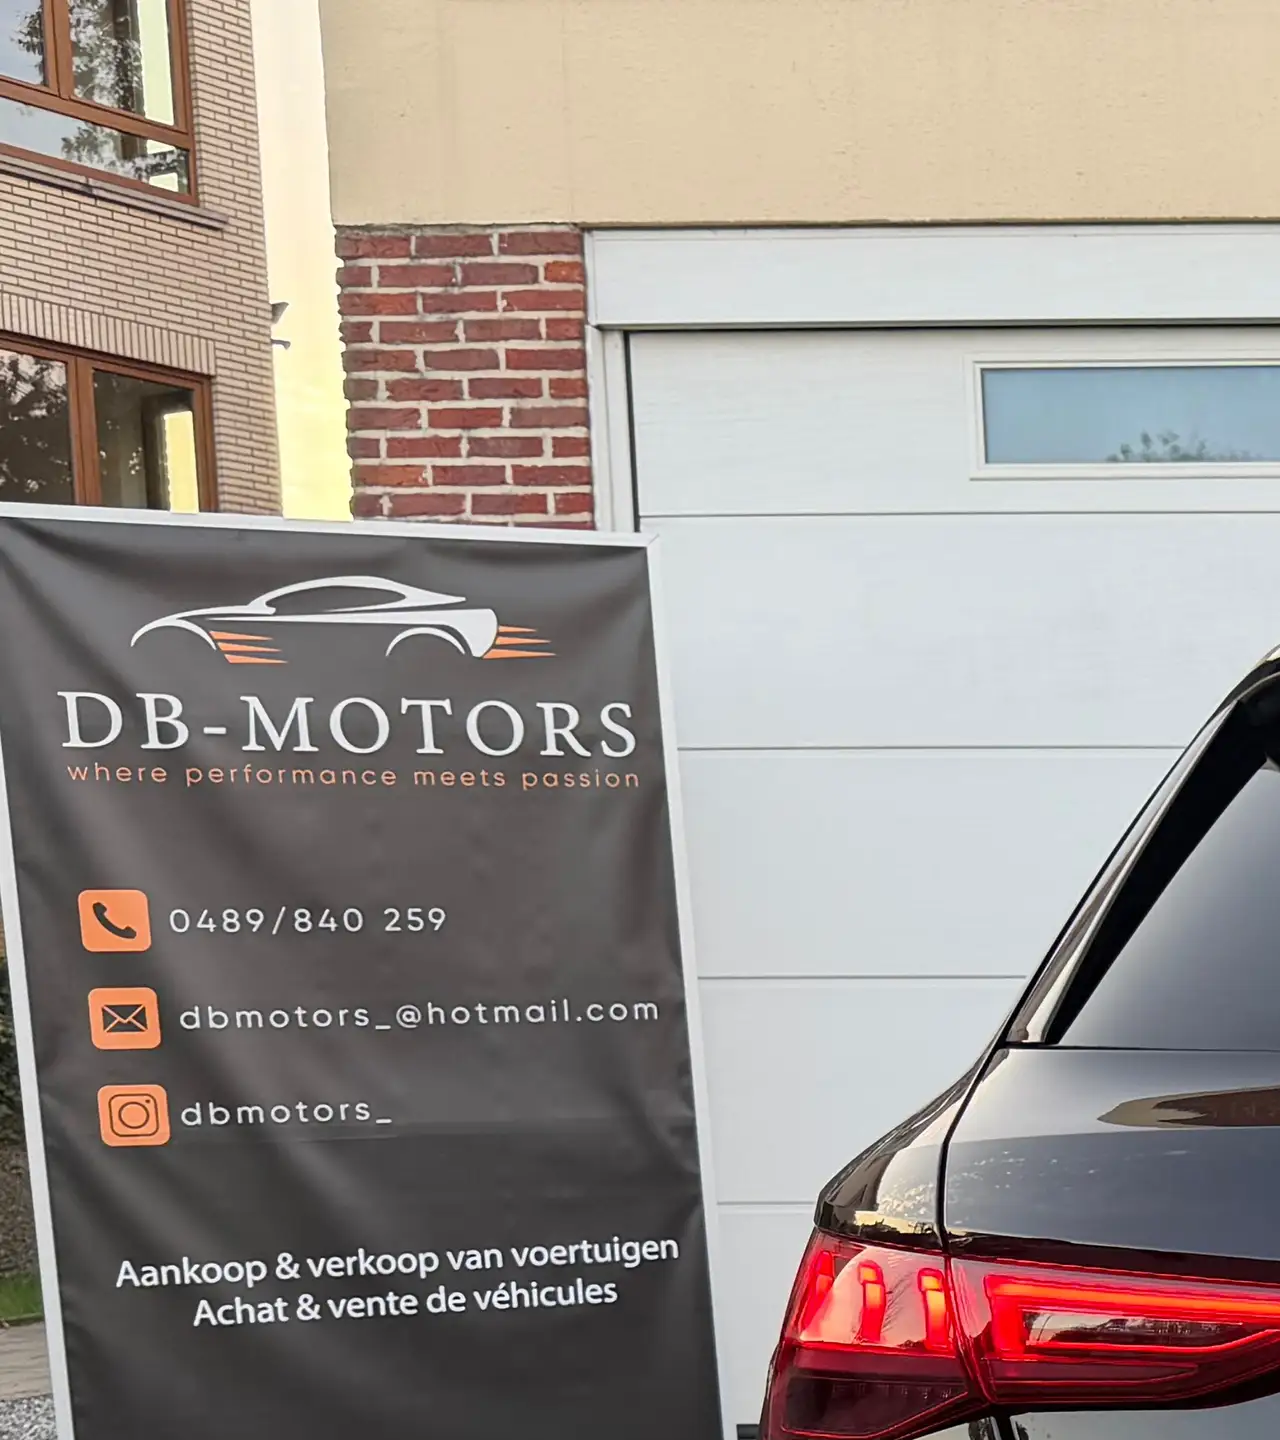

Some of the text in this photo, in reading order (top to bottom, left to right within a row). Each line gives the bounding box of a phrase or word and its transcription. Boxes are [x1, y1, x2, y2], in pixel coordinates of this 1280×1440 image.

[56, 691, 636, 758] DB-MOTORS
[67, 762, 639, 791] where performance meets passion
[169, 906, 446, 935] 0489/840 259
[179, 998, 658, 1030] dbmotors_@hotmail.com
[180, 1101, 393, 1126] dbmotors_
[115, 1235, 679, 1289] Aankoop & verkoop van voertuigen
[193, 1277, 618, 1327] Achat & vente de véhicules
